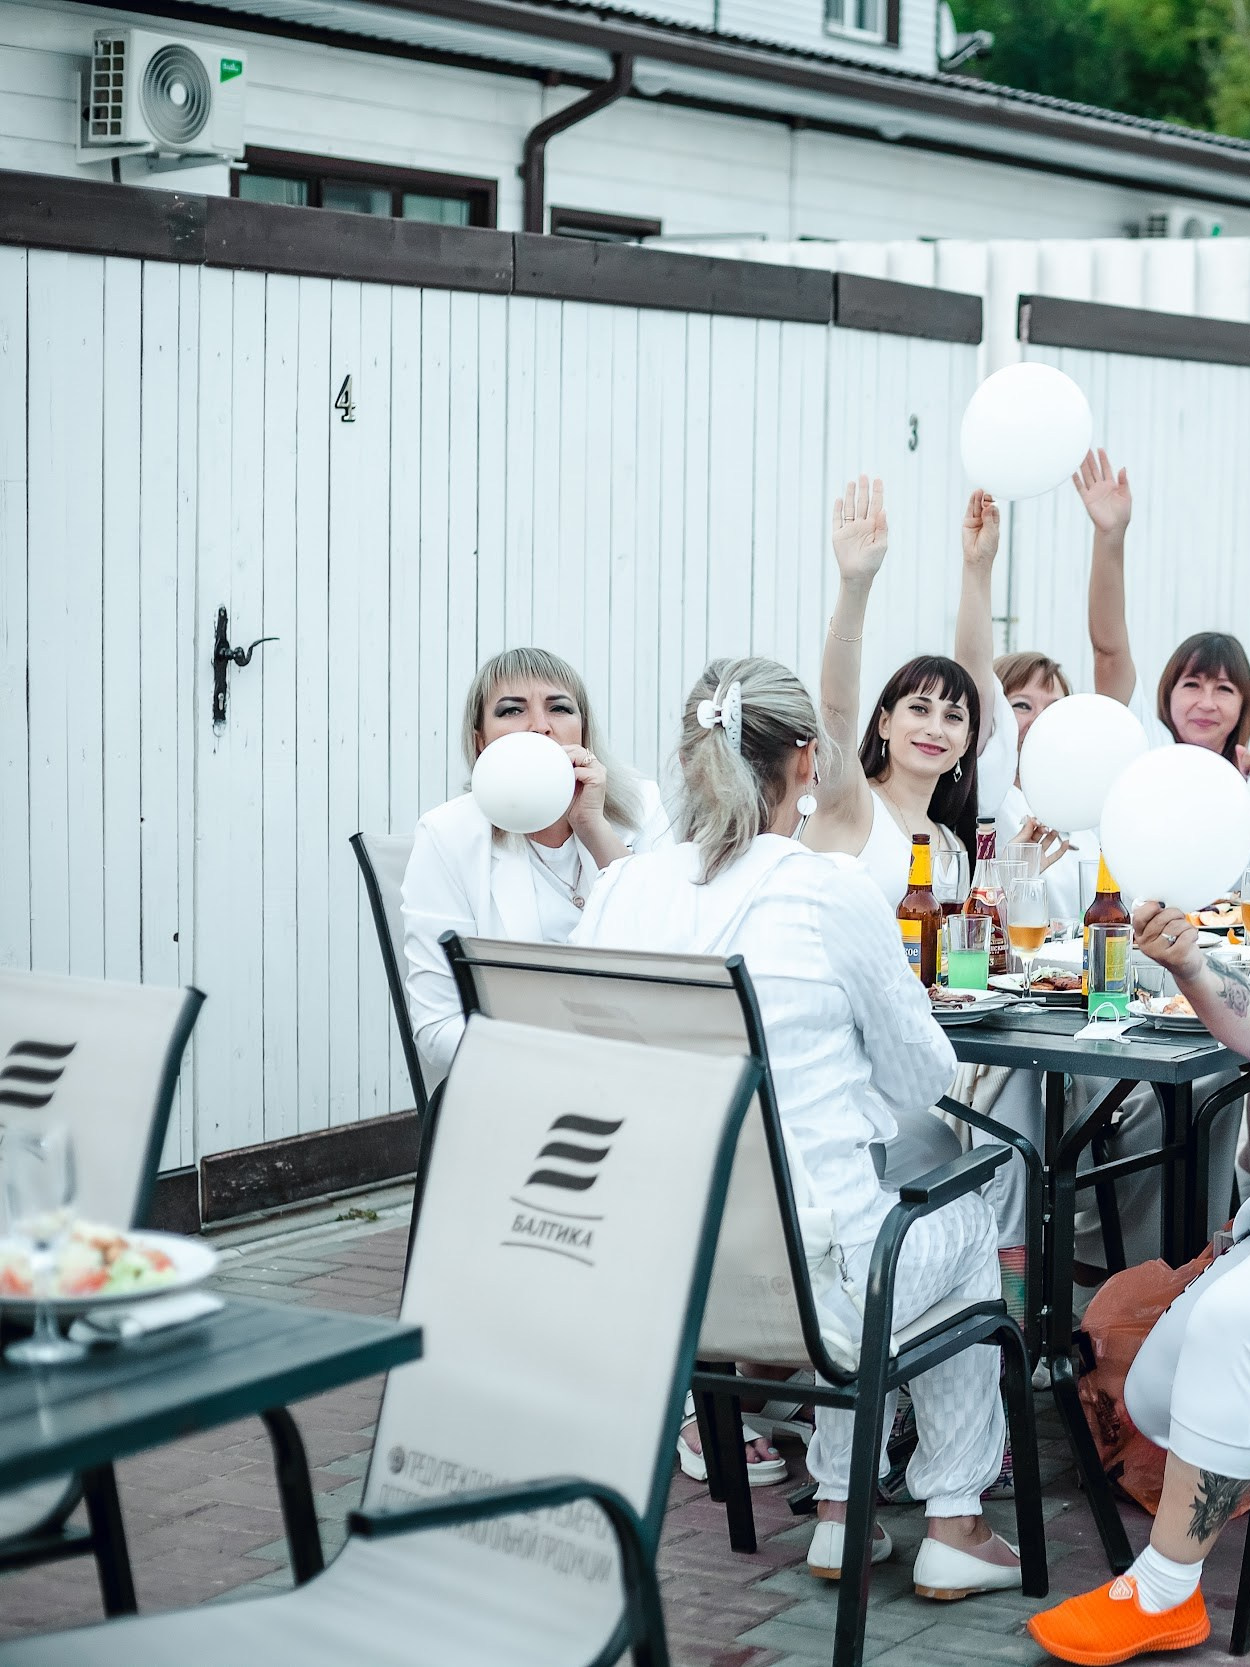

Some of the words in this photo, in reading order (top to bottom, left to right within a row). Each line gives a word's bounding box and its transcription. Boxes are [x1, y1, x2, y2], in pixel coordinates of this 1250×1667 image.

[335, 374, 356, 422] 4
[909, 413, 918, 451] 3
[512, 1214, 593, 1248] БАЛТИКА
